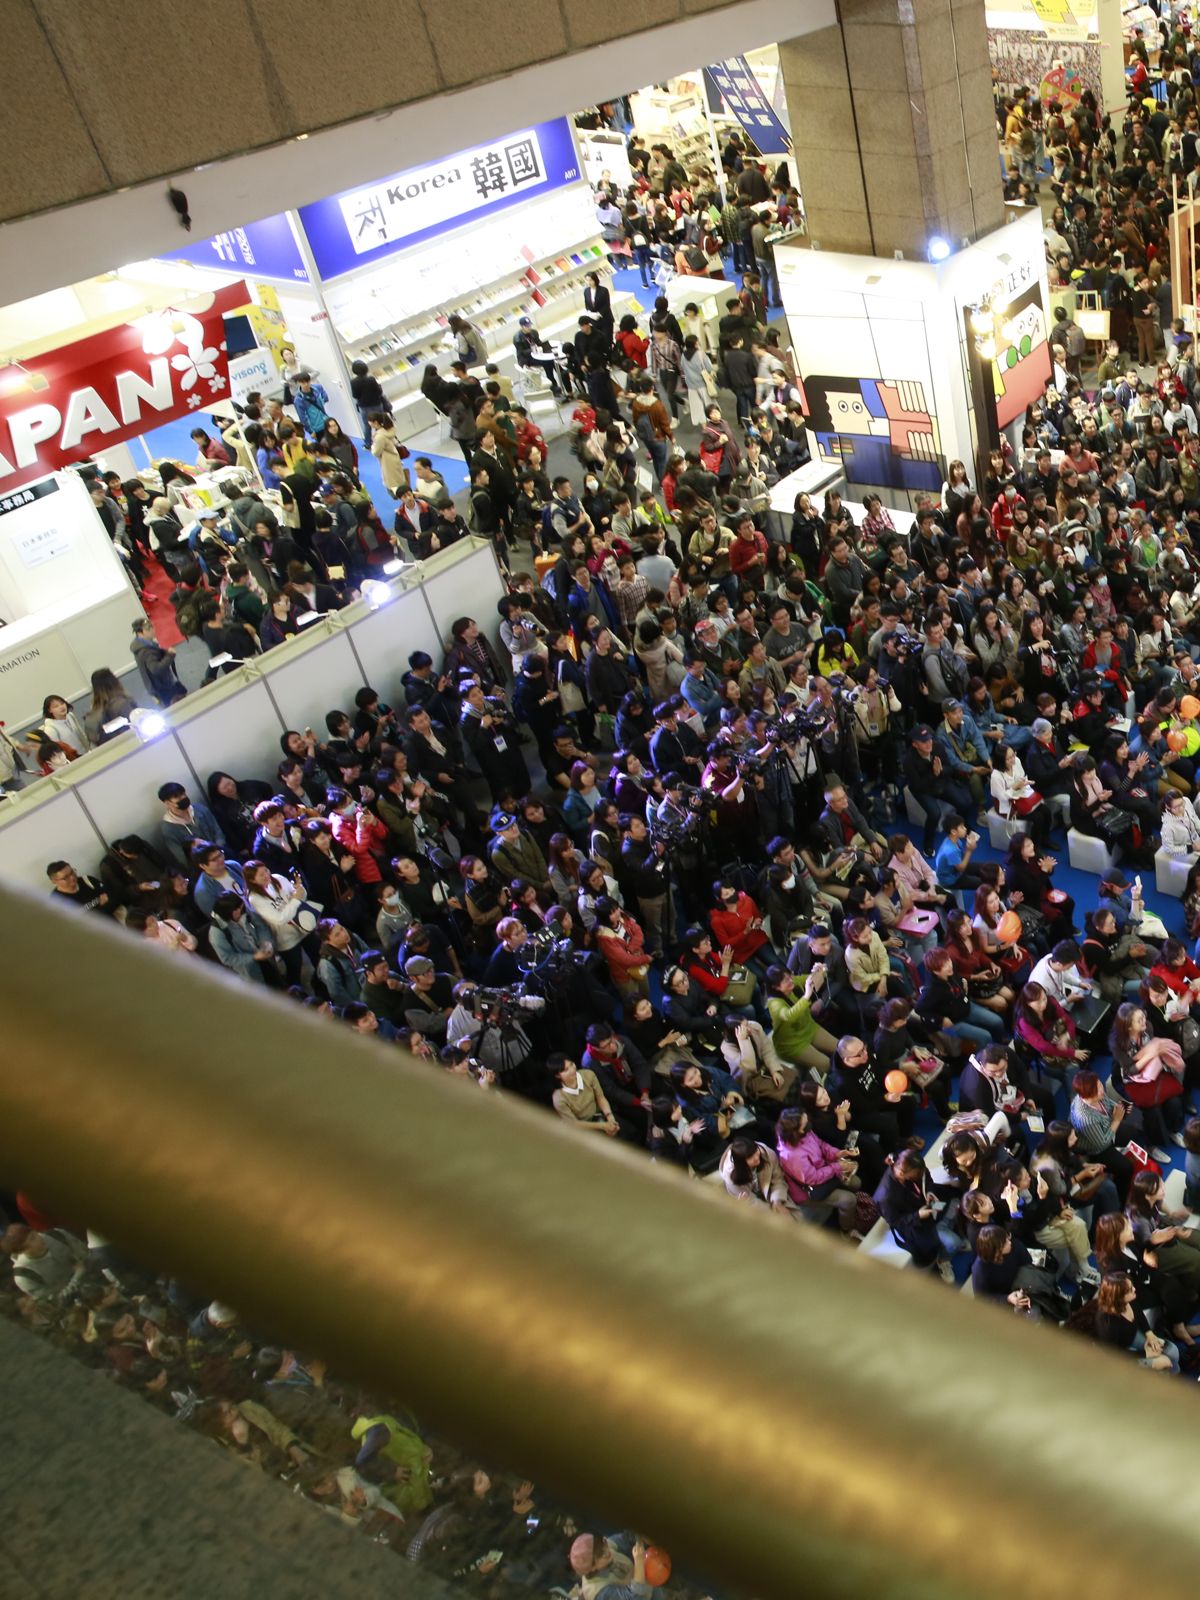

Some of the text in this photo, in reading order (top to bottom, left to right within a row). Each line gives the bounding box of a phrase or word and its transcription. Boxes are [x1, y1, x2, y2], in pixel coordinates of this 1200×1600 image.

[1059, 45, 1085, 62] on
[386, 166, 462, 205] Korea
[470, 138, 541, 199] 韓國
